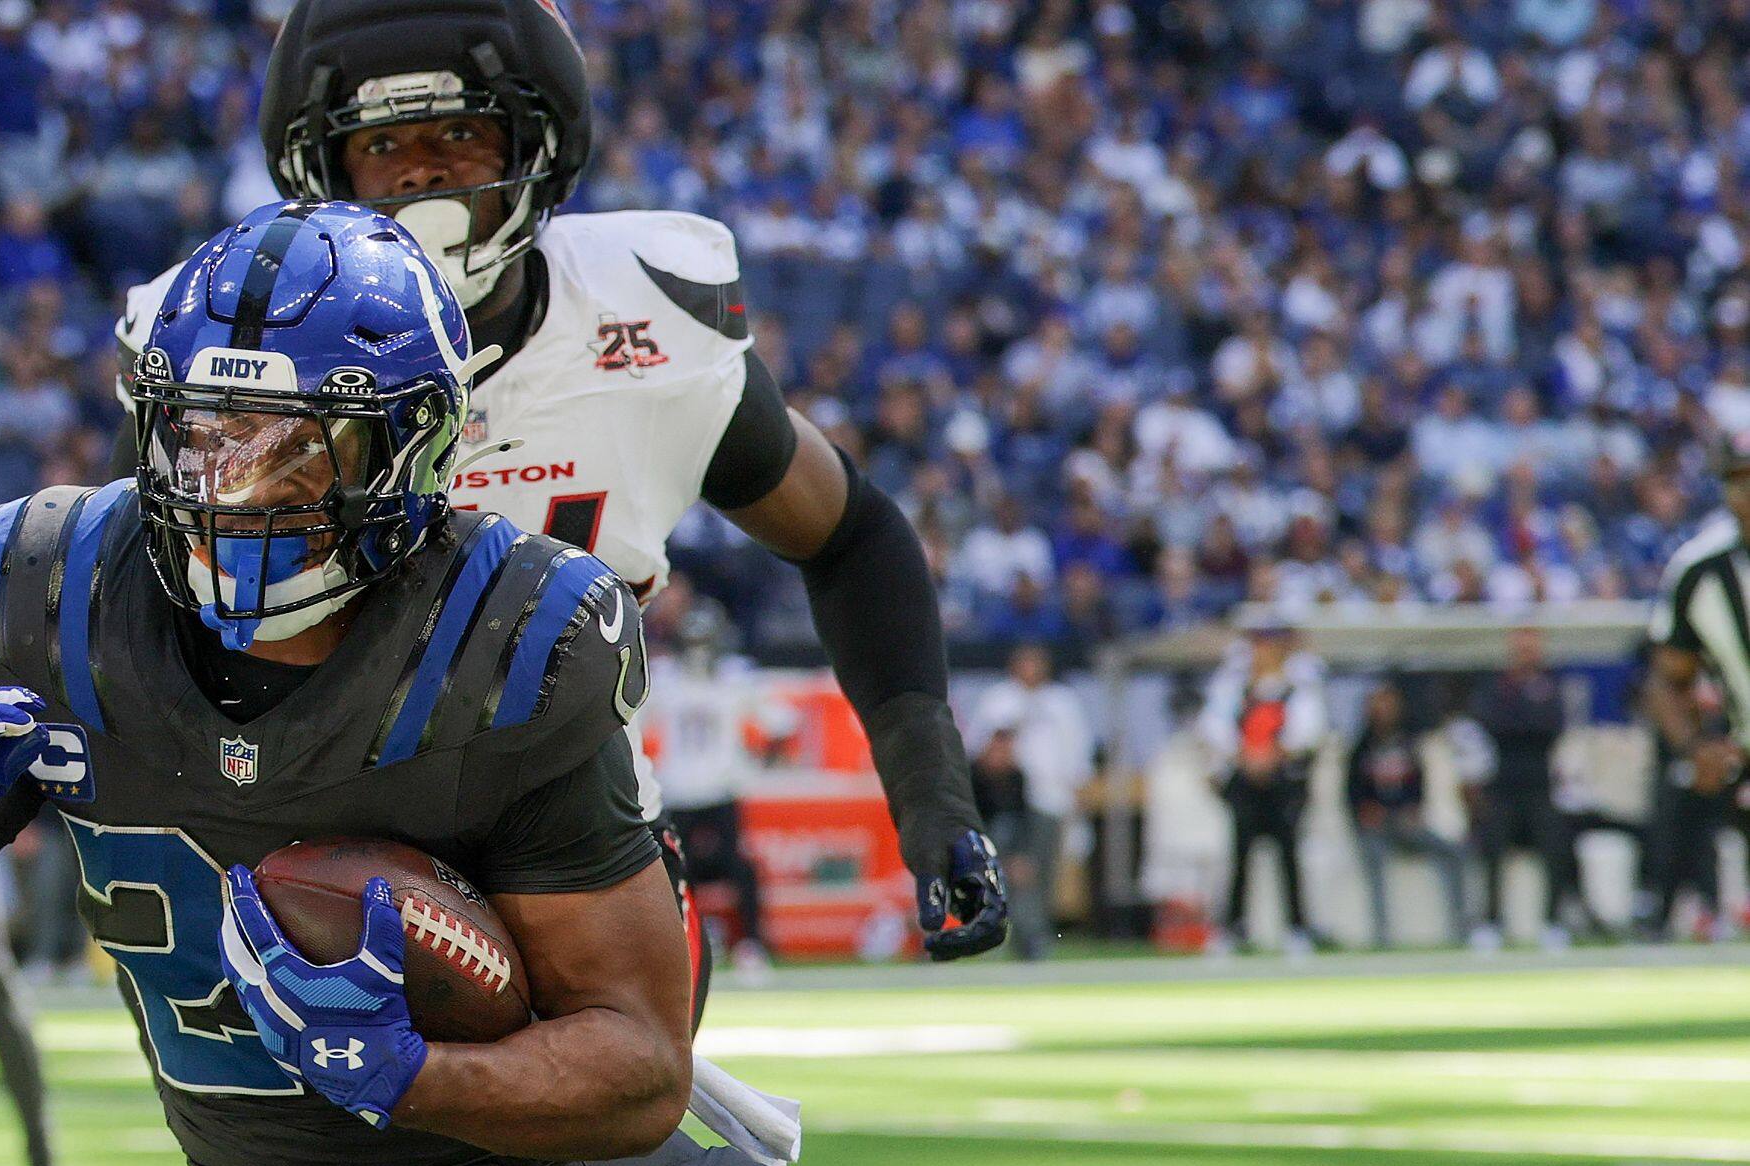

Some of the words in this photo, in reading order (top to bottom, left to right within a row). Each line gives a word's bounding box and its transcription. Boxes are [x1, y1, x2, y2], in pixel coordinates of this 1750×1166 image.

[597, 320, 661, 370] 25
[210, 357, 268, 380] INDY
[322, 385, 373, 394] OAKLEY
[28, 730, 86, 783] C
[227, 757, 253, 778] NFL
